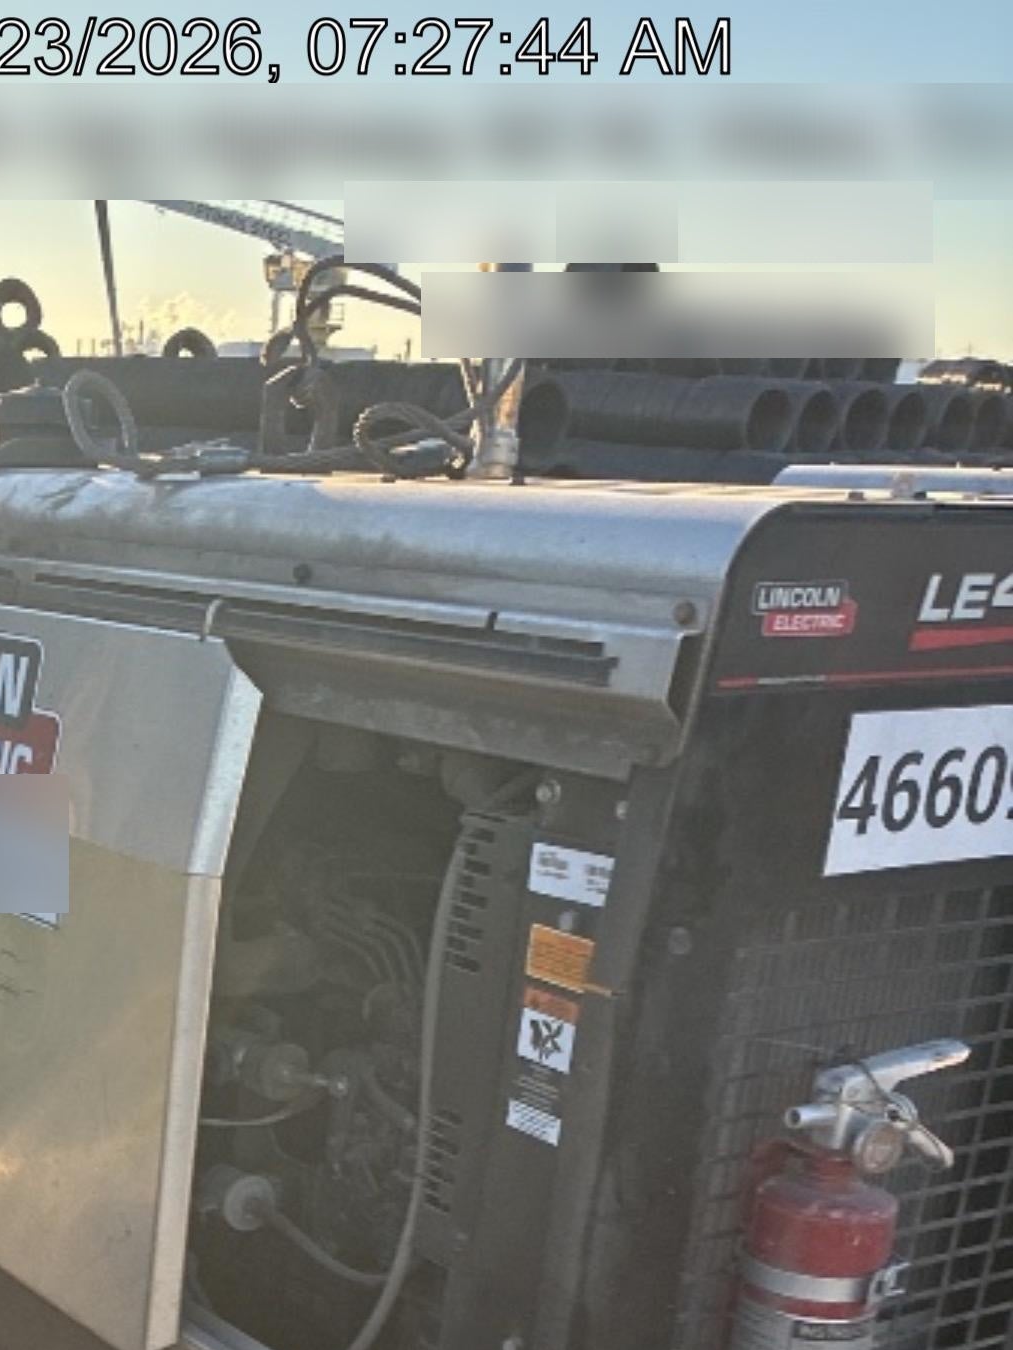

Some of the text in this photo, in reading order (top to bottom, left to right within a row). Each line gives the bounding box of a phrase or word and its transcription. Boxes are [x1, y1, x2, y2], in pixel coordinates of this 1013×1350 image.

[757, 586, 841, 610] LINCOLN
[771, 614, 846, 632] ELECTRIC
[836, 745, 1013, 836] 4660
